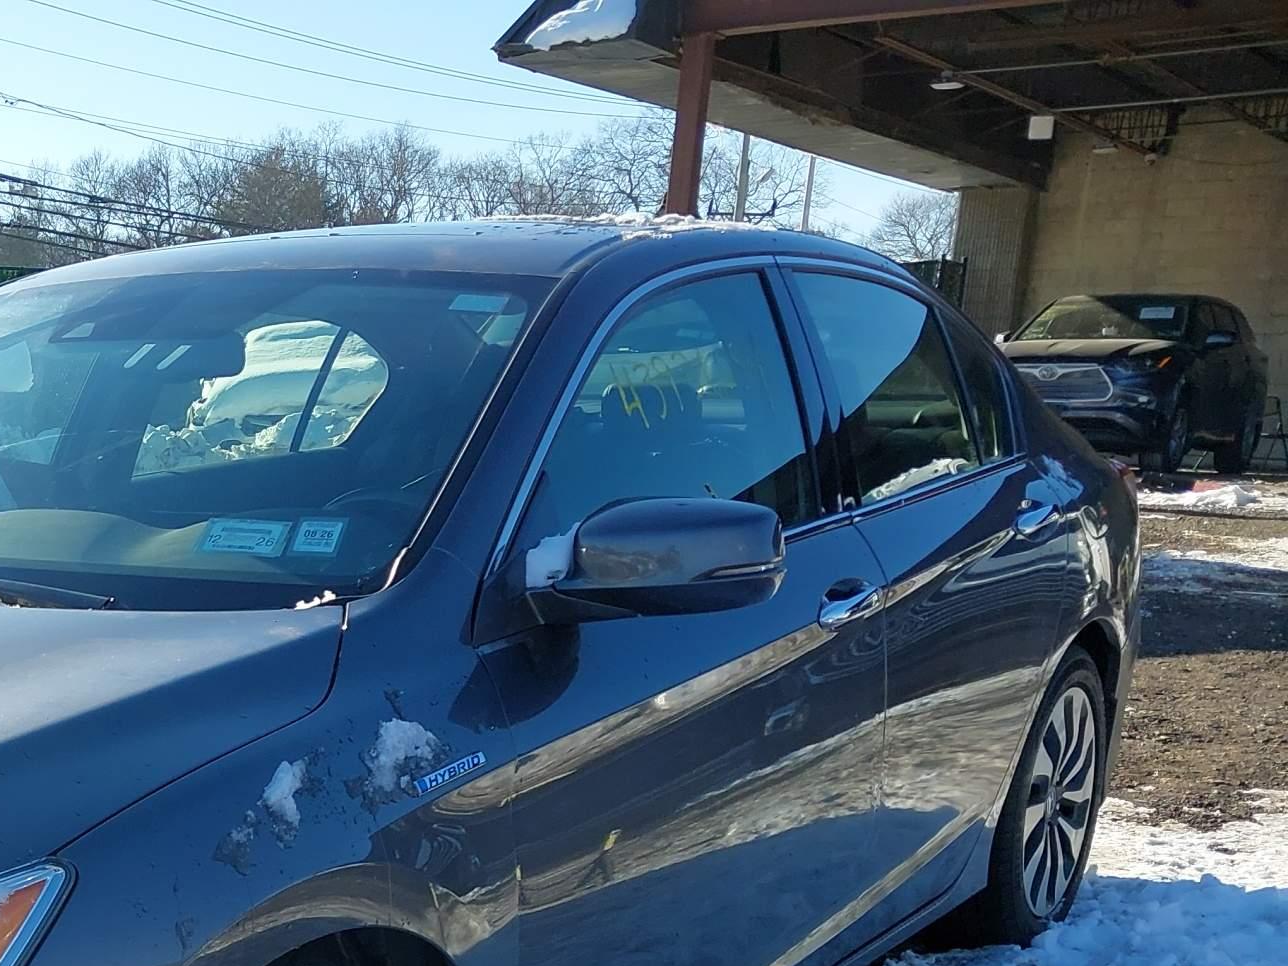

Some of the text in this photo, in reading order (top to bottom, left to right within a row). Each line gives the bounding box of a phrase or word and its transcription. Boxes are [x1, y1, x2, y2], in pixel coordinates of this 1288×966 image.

[319, 529, 334, 538] 26
[207, 534, 223, 544] 12
[255, 536, 276, 547] 26
[428, 755, 481, 789] HYBRID
